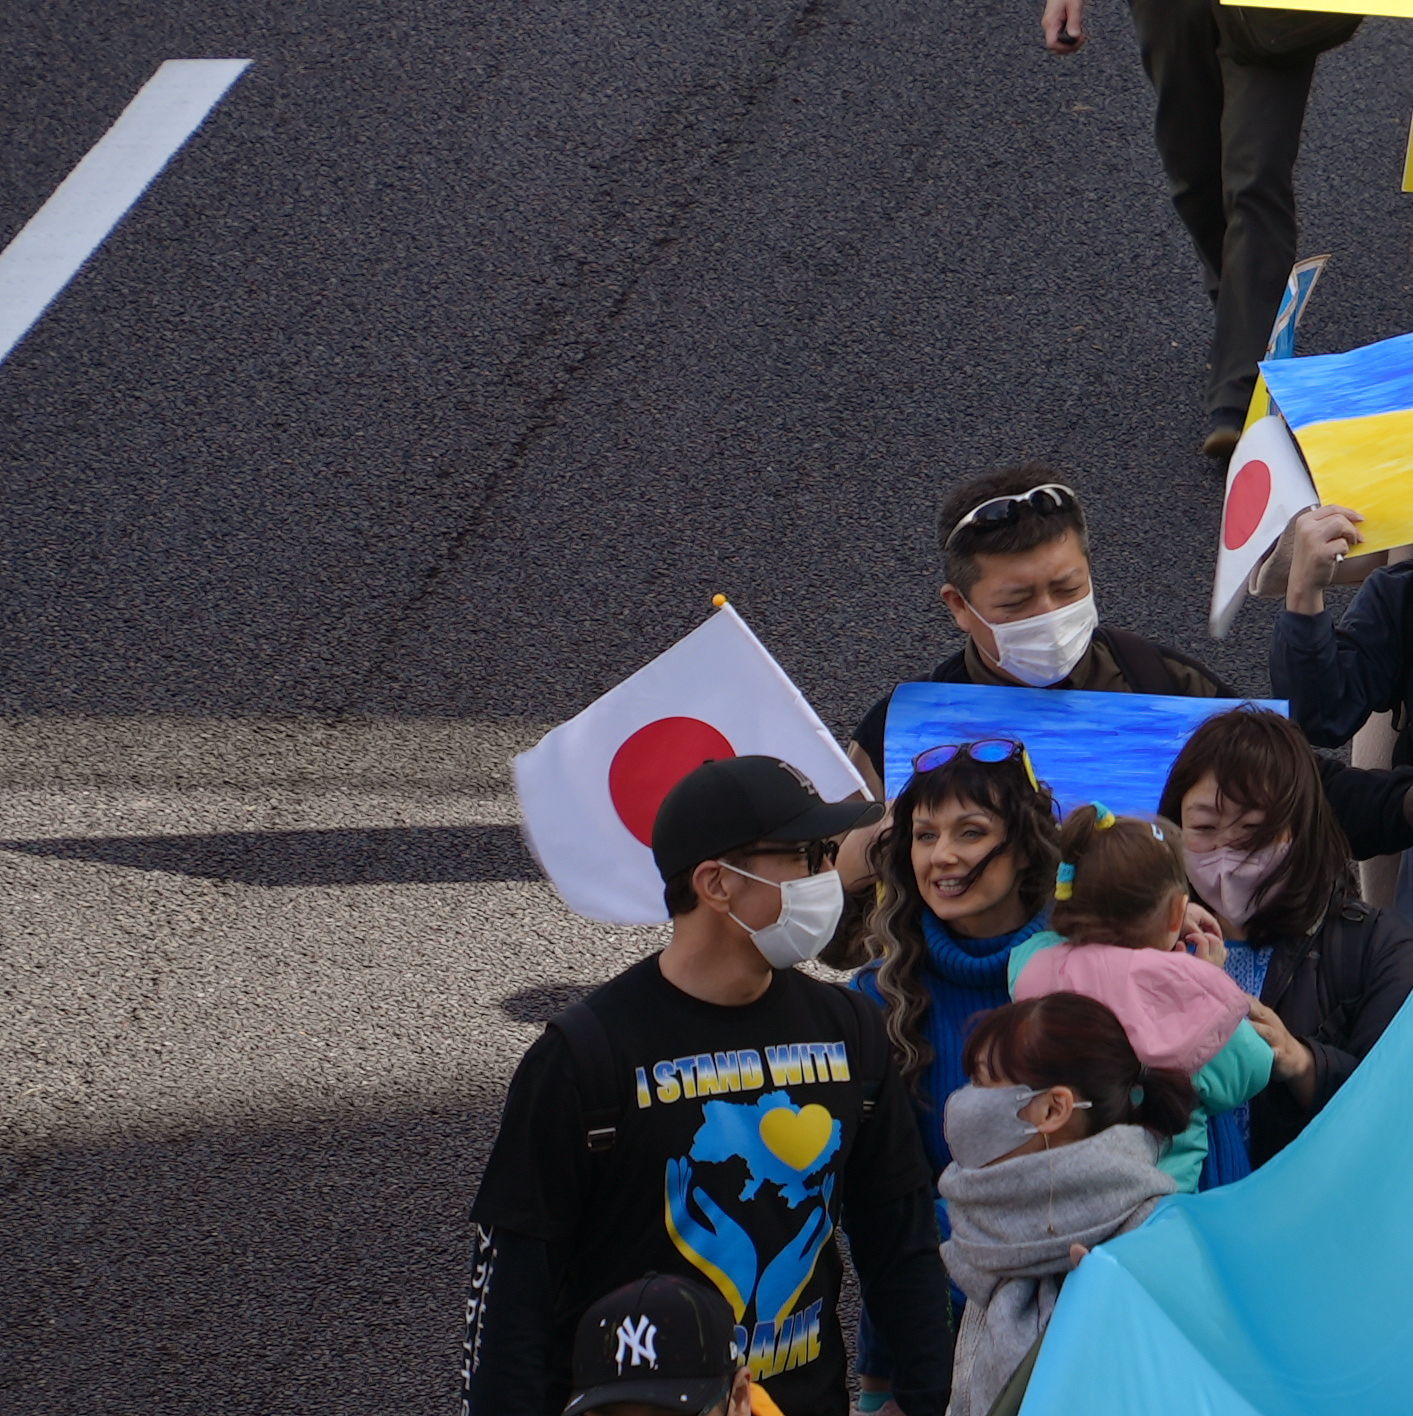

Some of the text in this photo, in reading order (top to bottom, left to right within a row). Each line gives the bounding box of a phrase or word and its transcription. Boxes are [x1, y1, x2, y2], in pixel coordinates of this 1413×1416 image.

[635, 1041, 851, 1109] I STAND WITH
